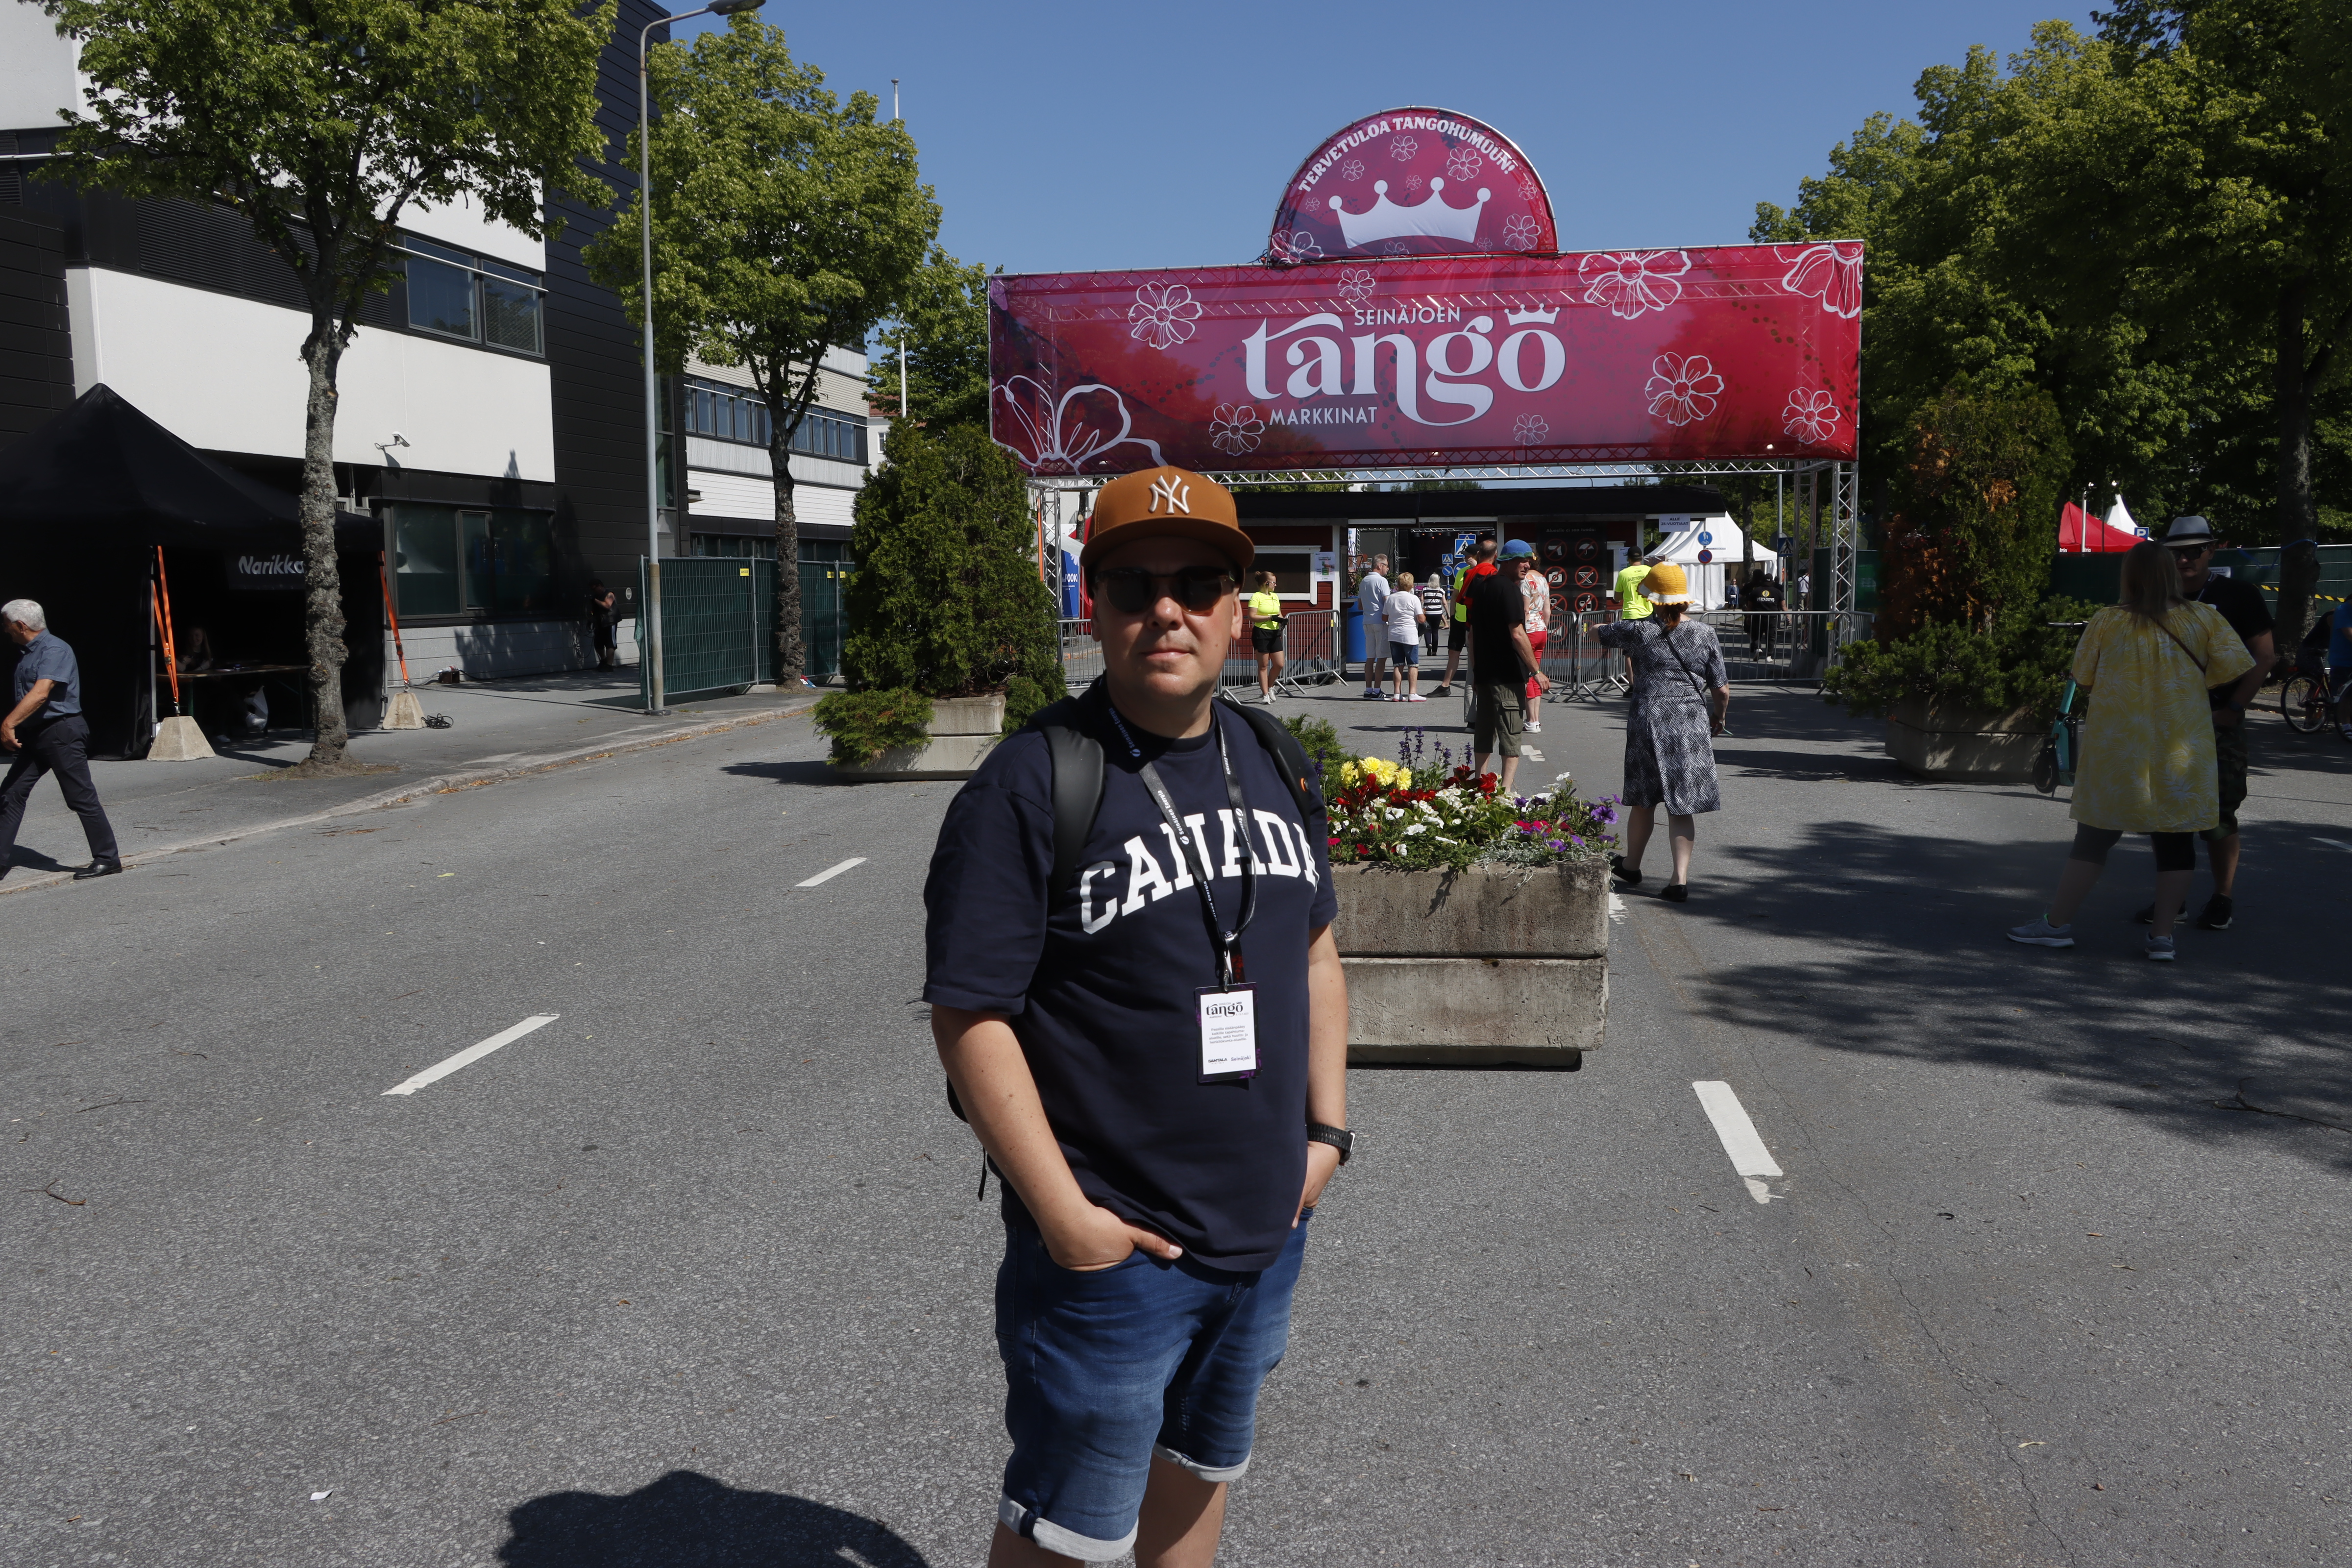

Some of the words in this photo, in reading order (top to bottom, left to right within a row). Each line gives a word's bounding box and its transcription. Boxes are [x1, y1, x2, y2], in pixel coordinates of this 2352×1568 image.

[1298, 120, 1391, 193] TERVETULOA
[1392, 117, 1515, 174] TANGOHUMUUN!
[1354, 306, 1461, 326] SEINÄJOEN
[1269, 406, 1377, 426] MARKKINAT
[2136, 529, 2147, 537] P
[238, 554, 304, 574] Narikka
[1157, 790, 1171, 809] Energia
[1168, 809, 1184, 835] Seinäjoen
